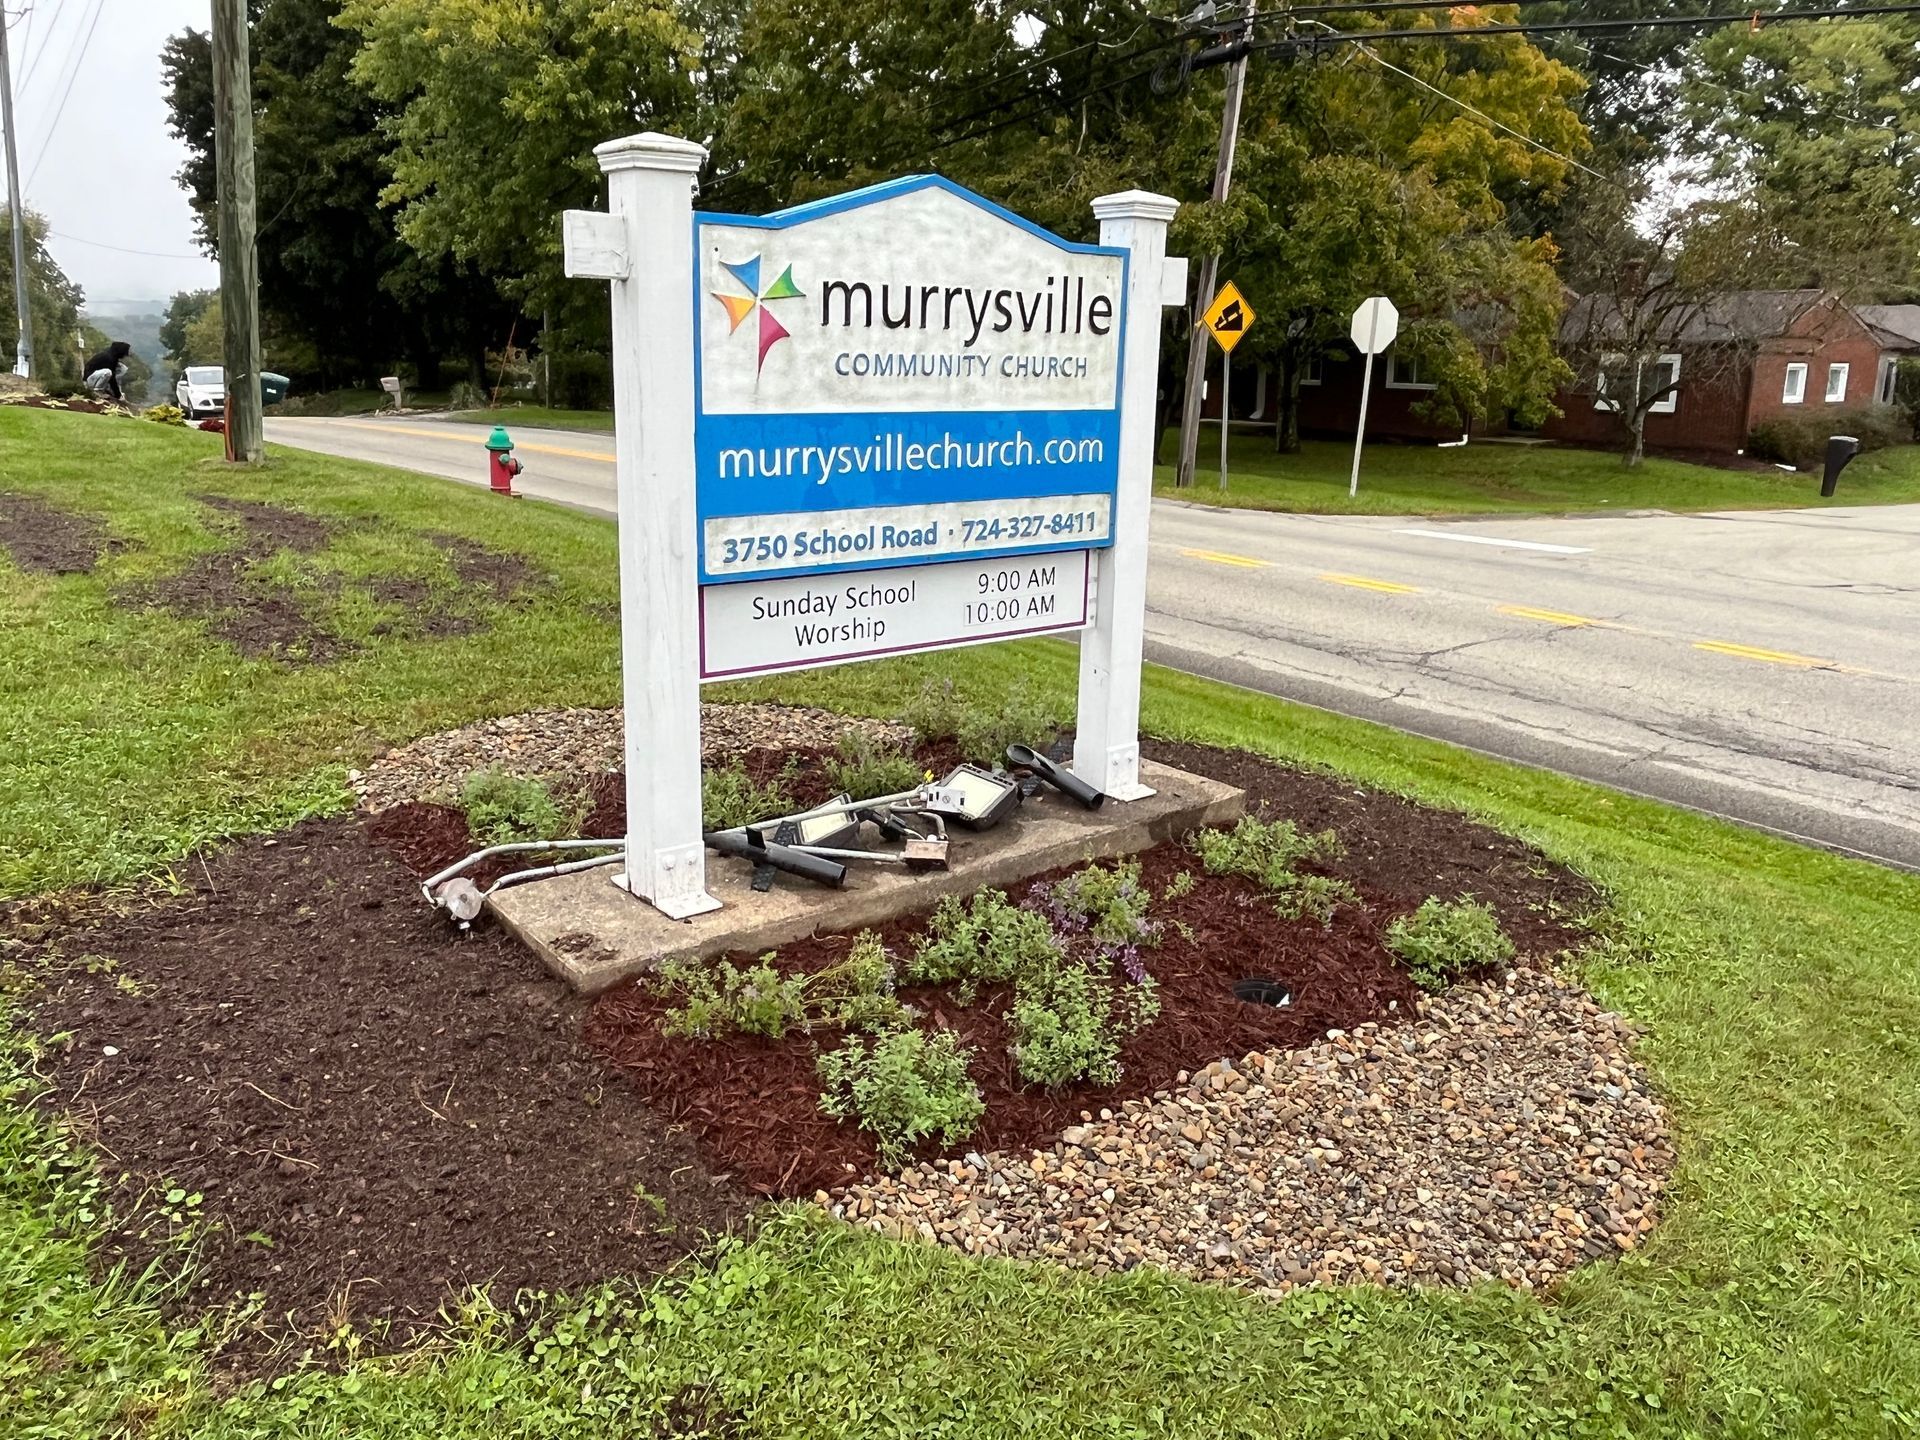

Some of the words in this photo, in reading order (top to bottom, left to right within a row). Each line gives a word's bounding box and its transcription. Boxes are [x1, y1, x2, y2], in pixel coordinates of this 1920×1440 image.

[822, 276, 1113, 347] murrysville
[836, 353, 991, 376] COMMUNITY
[1001, 355, 1087, 377] CHURCH
[719, 431, 1103, 484] murrysvillechurch.com
[723, 534, 787, 563] 3750
[794, 525, 875, 557] School
[883, 522, 937, 547] Road
[962, 511, 1095, 542] 724-327-8411
[752, 591, 837, 621] Sunday
[846, 581, 915, 609] School
[978, 571, 1021, 594] 9:00
[1027, 567, 1056, 587] AM
[795, 616, 885, 647] Worship
[965, 599, 1019, 624] 10:00
[1027, 595, 1055, 615] AM
